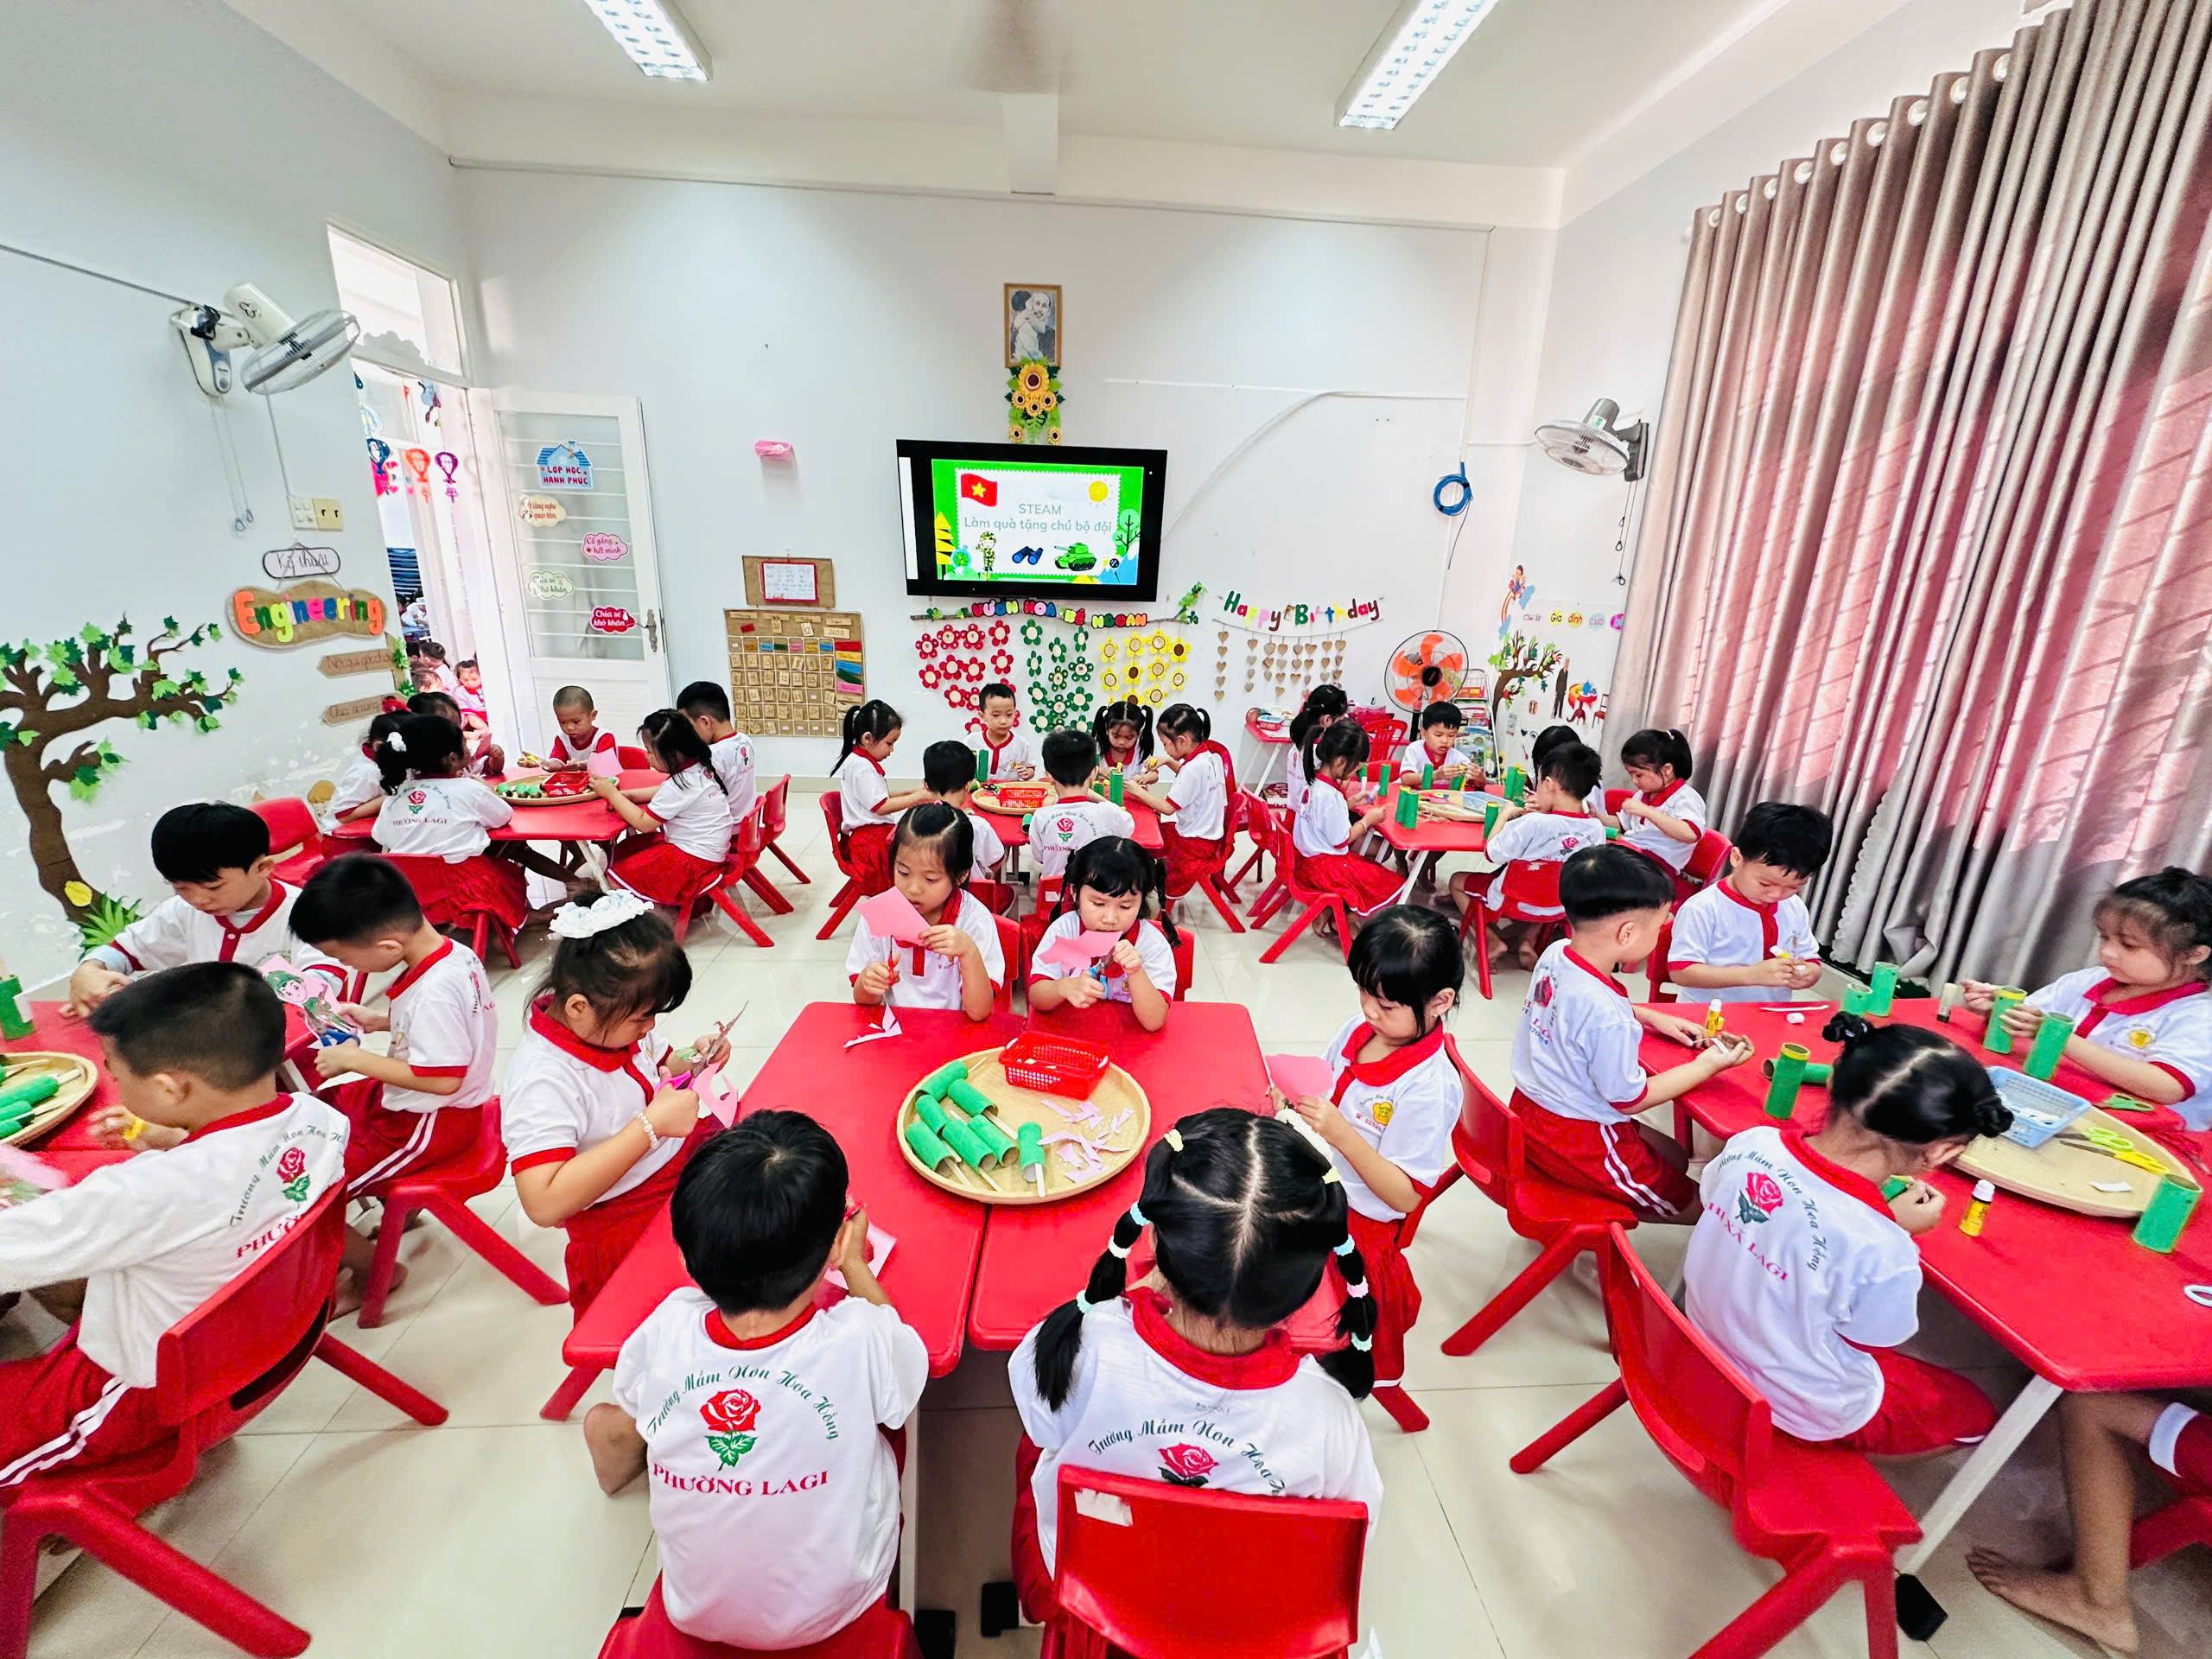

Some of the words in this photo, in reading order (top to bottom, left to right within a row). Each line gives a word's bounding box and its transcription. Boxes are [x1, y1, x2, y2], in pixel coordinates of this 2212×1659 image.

[964, 517, 990, 528] Làm
[994, 518, 1016, 531] quà
[1020, 519, 1047, 532] tặng
[1052, 519, 1071, 531] chú
[1076, 520, 1090, 535] bộ
[1094, 521, 1112, 535] đội
[1019, 503, 1062, 515] STEAM
[234, 590, 384, 642] Engineering
[1023, 600, 1057, 617] HOA
[1064, 608, 1086, 626] BÉ
[1091, 613, 1148, 629] NGOAN
[1224, 590, 1281, 632] Happy
[1294, 597, 1380, 626] Birthday
[1777, 1168, 1802, 1195] Non
[1801, 1198, 1820, 1230] Hoa
[237, 1214, 302, 1259] PHƯỜ
[1806, 1236, 1828, 1272] Hồng
[1747, 1242, 1789, 1281] LAGI
[646, 1389, 681, 1438] Trường
[682, 1370, 721, 1395] Mầm
[728, 1363, 771, 1381] Non
[777, 1370, 813, 1401] Hoa
[812, 1395, 839, 1440] Hồng
[1088, 1427, 1134, 1456] Trường
[1137, 1417, 1185, 1437] Mầm
[1192, 1419, 1236, 1448] Non
[1239, 1441, 1273, 1479] Hoa
[653, 1462, 753, 1496] PHƯỜNG
[761, 1470, 830, 1496] LAGI
